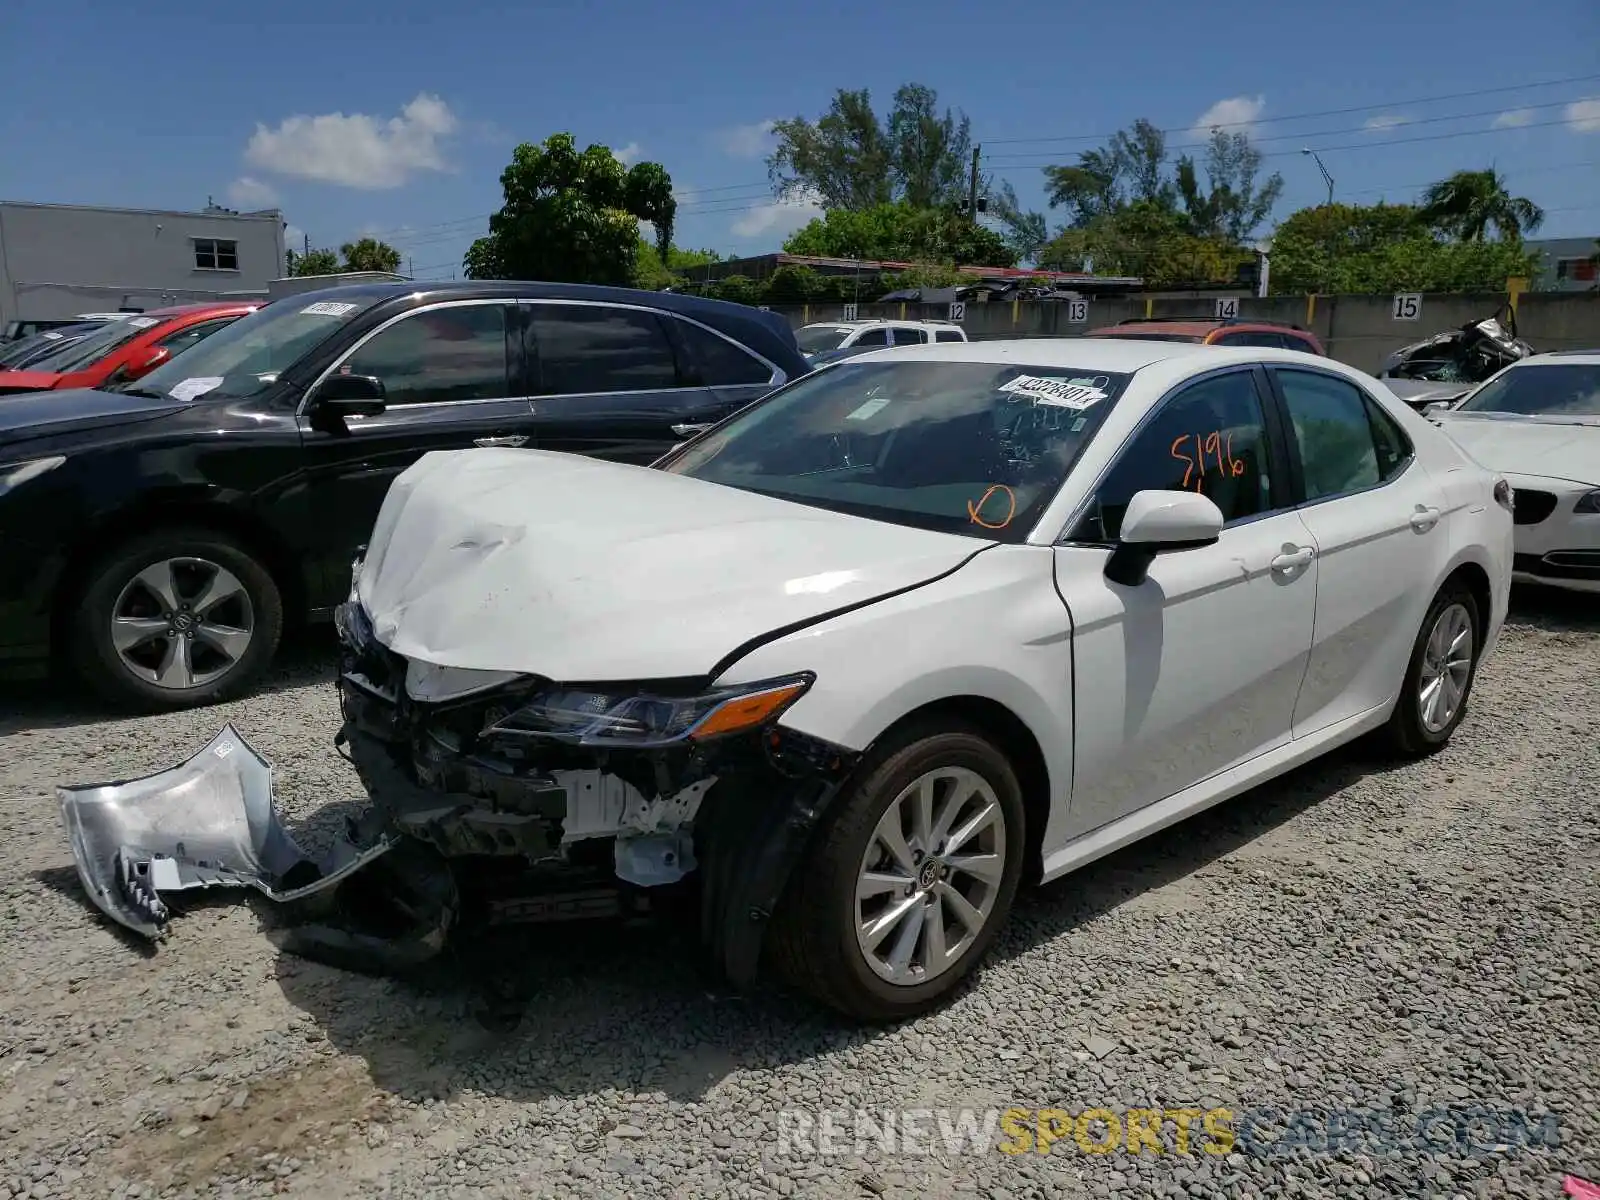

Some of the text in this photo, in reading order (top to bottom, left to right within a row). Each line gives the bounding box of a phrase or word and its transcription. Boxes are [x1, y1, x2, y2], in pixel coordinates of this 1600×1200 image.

[846, 304, 856, 320] 11
[951, 303, 963, 320] 12
[1071, 303, 1086, 320] 13
[1219, 300, 1236, 317] 14
[1395, 297, 1417, 317] 15
